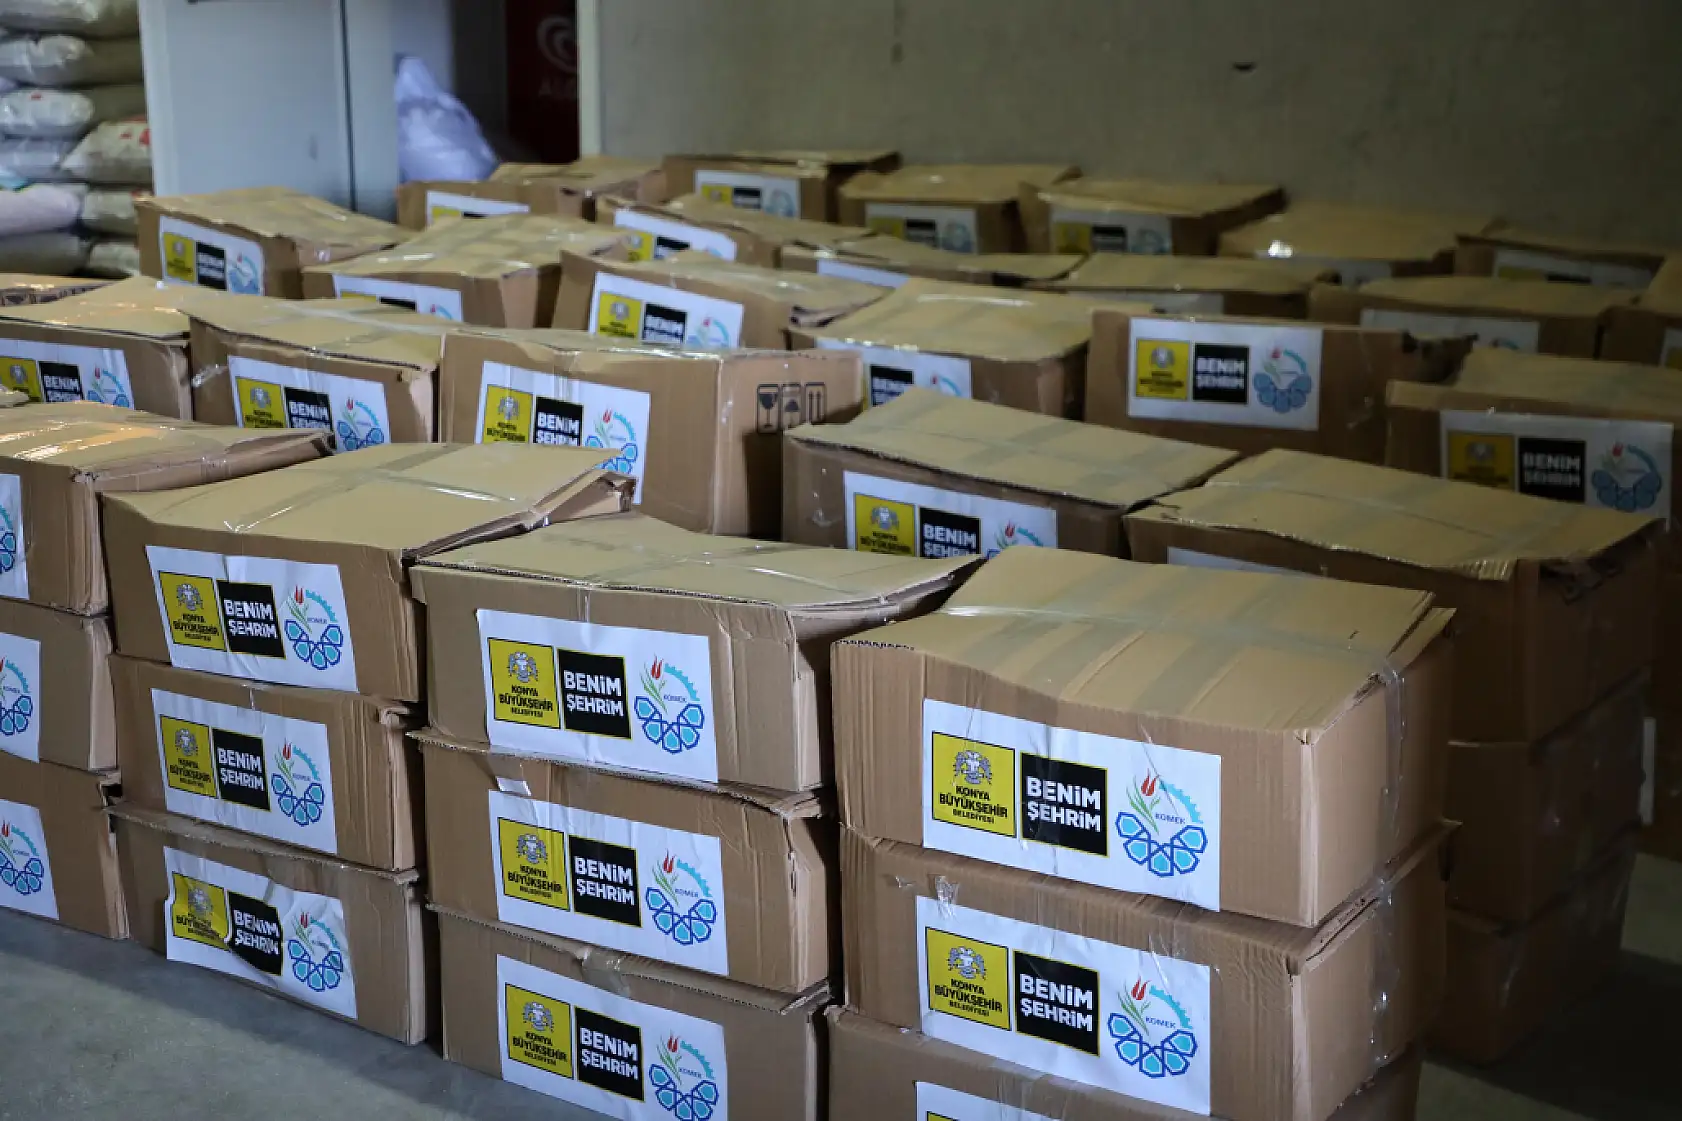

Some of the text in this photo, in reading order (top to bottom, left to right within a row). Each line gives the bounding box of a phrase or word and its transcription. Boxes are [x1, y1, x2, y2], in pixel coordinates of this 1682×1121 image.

[224, 599, 274, 621] BENİM
[563, 669, 622, 697] BENİM
[567, 693, 624, 717] ŞEHRİM
[218, 748, 262, 774] BENİM
[955, 785, 990, 801] KONYA
[1025, 776, 1101, 810] BENİM
[1027, 802, 1101, 832] ŞEHRİM
[574, 855, 633, 887] BENİM
[576, 878, 635, 906] ŞEHRİM
[950, 979, 985, 996] KONYA
[1019, 973, 1093, 1011] BENİM
[1021, 998, 1093, 1032] ŞEHRİM
[580, 1027, 639, 1061] BENİM
[581, 1049, 639, 1080] ŞEHRİM
